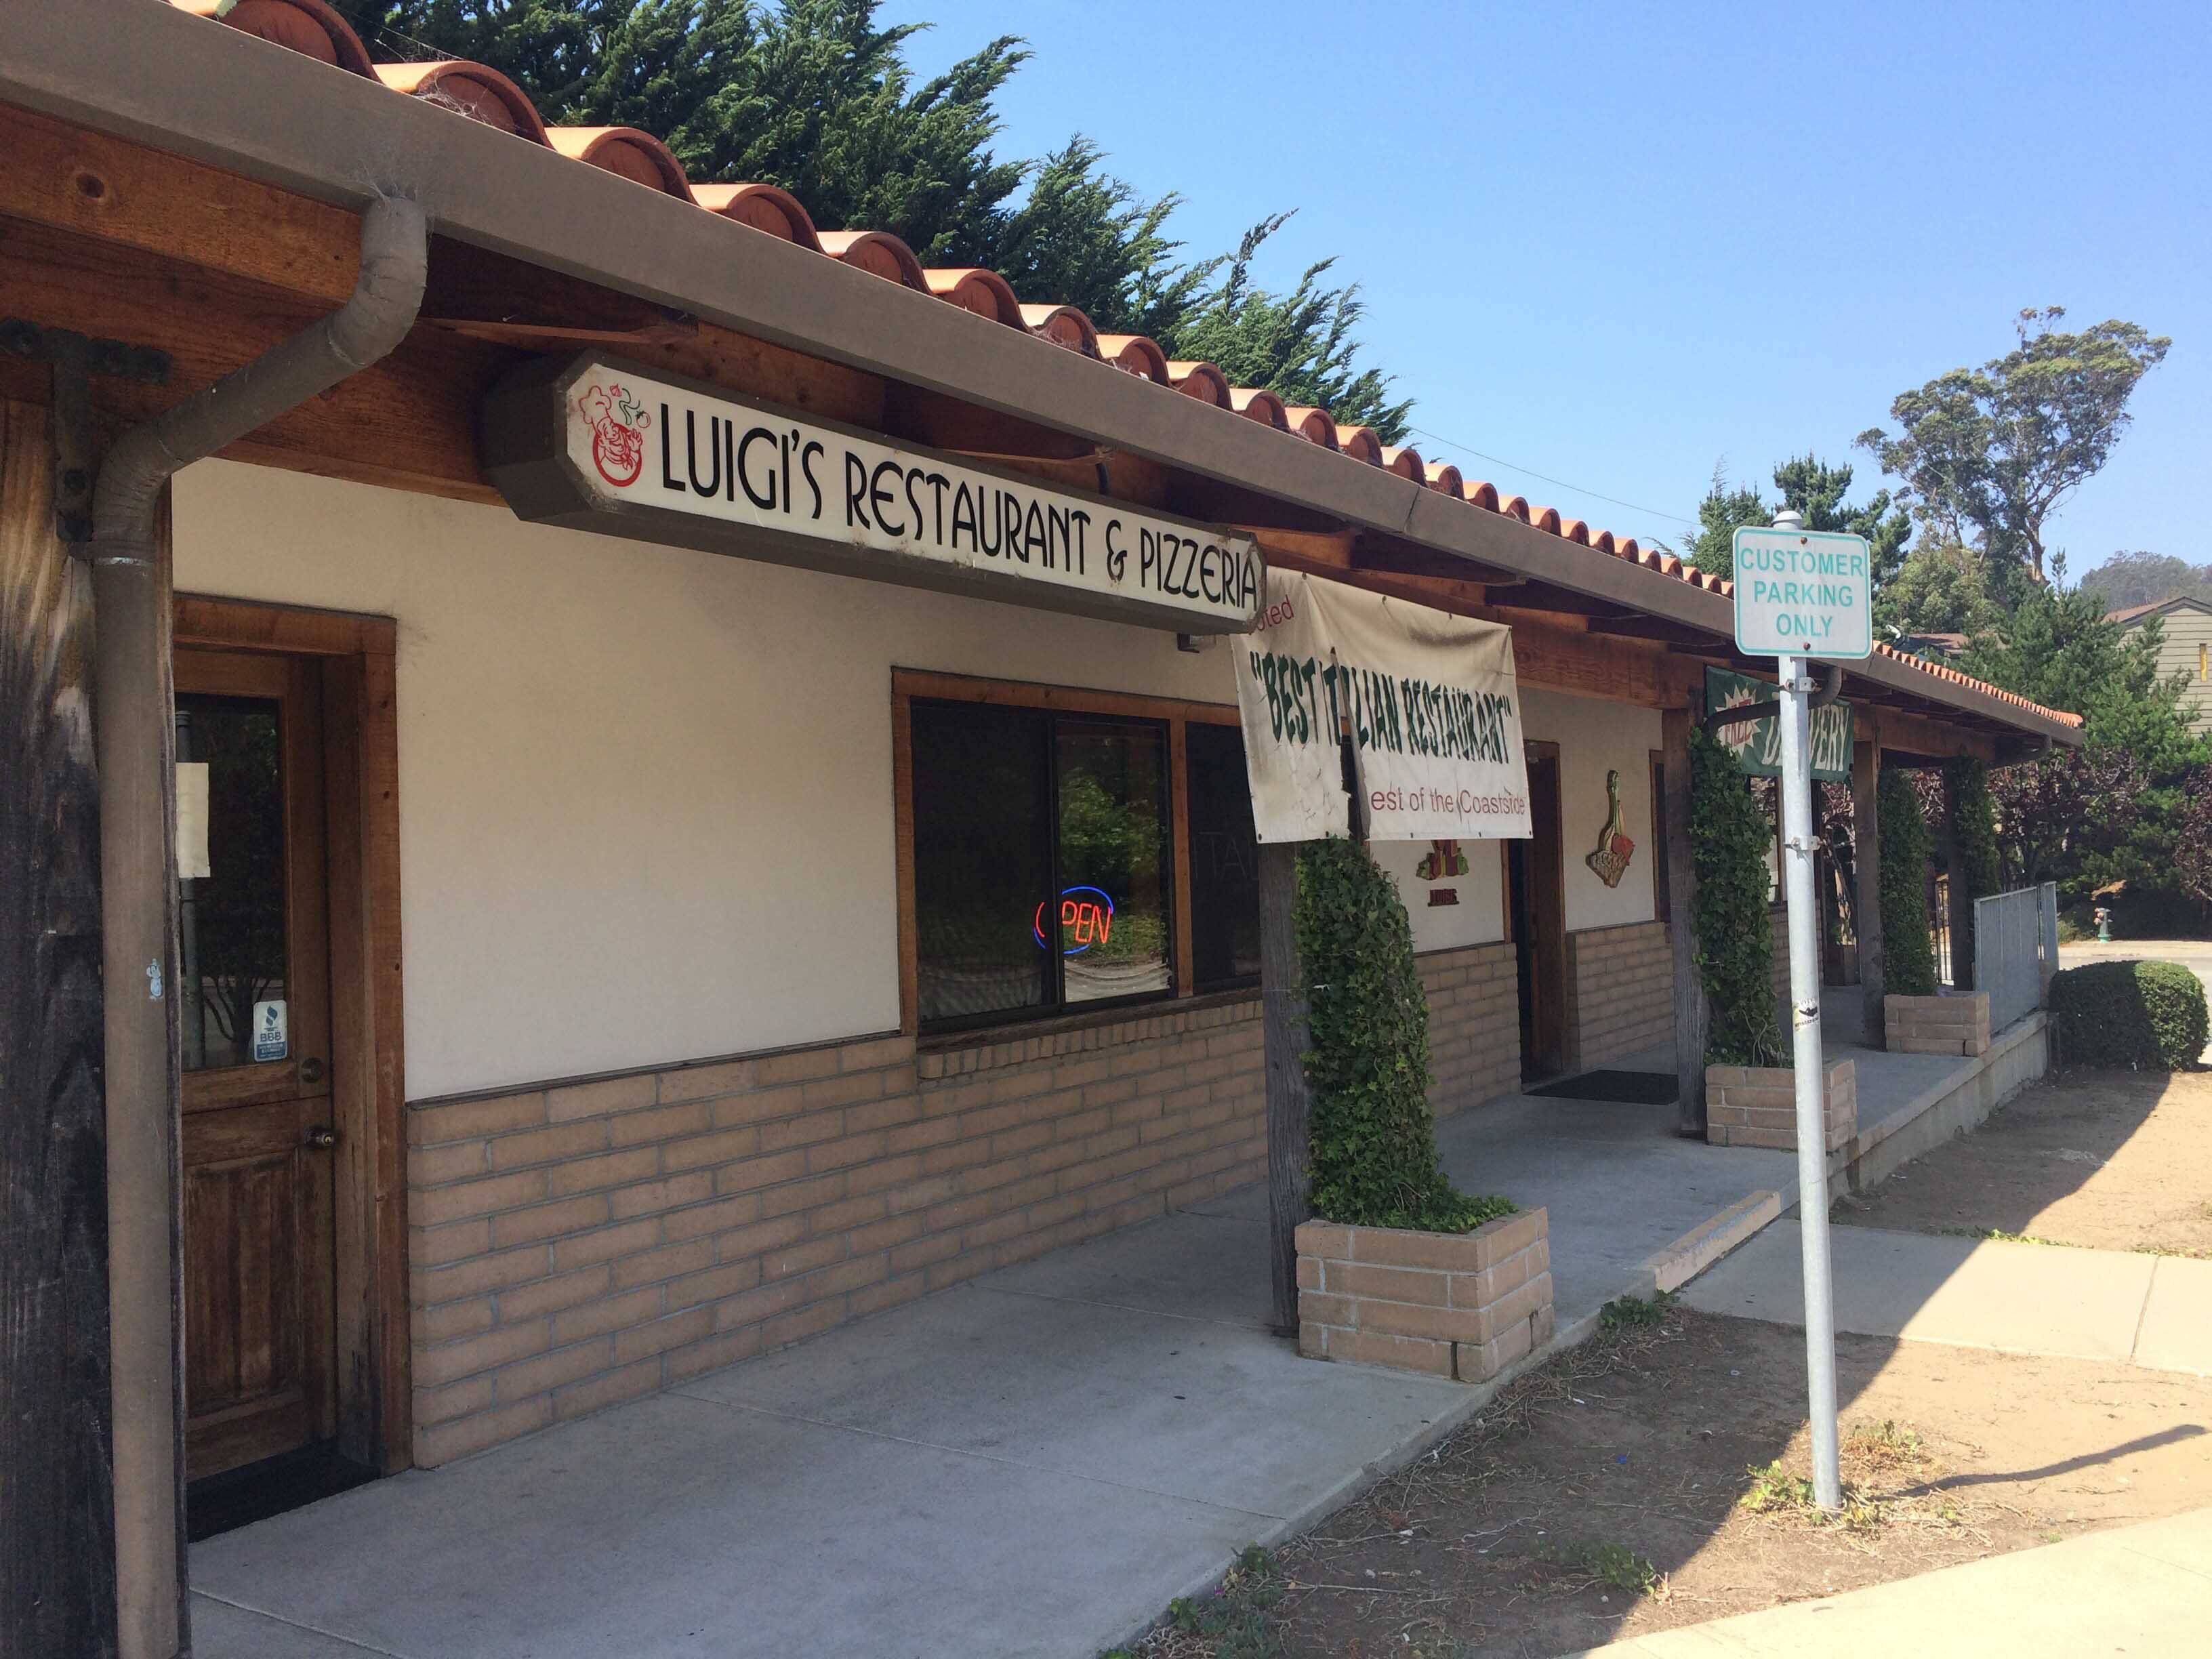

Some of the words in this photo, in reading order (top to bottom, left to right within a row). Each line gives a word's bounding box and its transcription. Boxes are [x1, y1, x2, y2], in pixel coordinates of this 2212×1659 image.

[660, 403, 824, 520] LUIGI'S
[845, 450, 1091, 575] RESTAURANT
[1105, 518, 1128, 583] &
[1140, 527, 1257, 611] PIZZERIA
[1740, 547, 1864, 577] CUSTOMER
[1754, 580, 1853, 608] PARKING
[1776, 613, 1833, 638] ONLY
[1409, 786, 1425, 813] of
[1430, 787, 1454, 813] the
[260, 1031, 283, 1042] BBB
